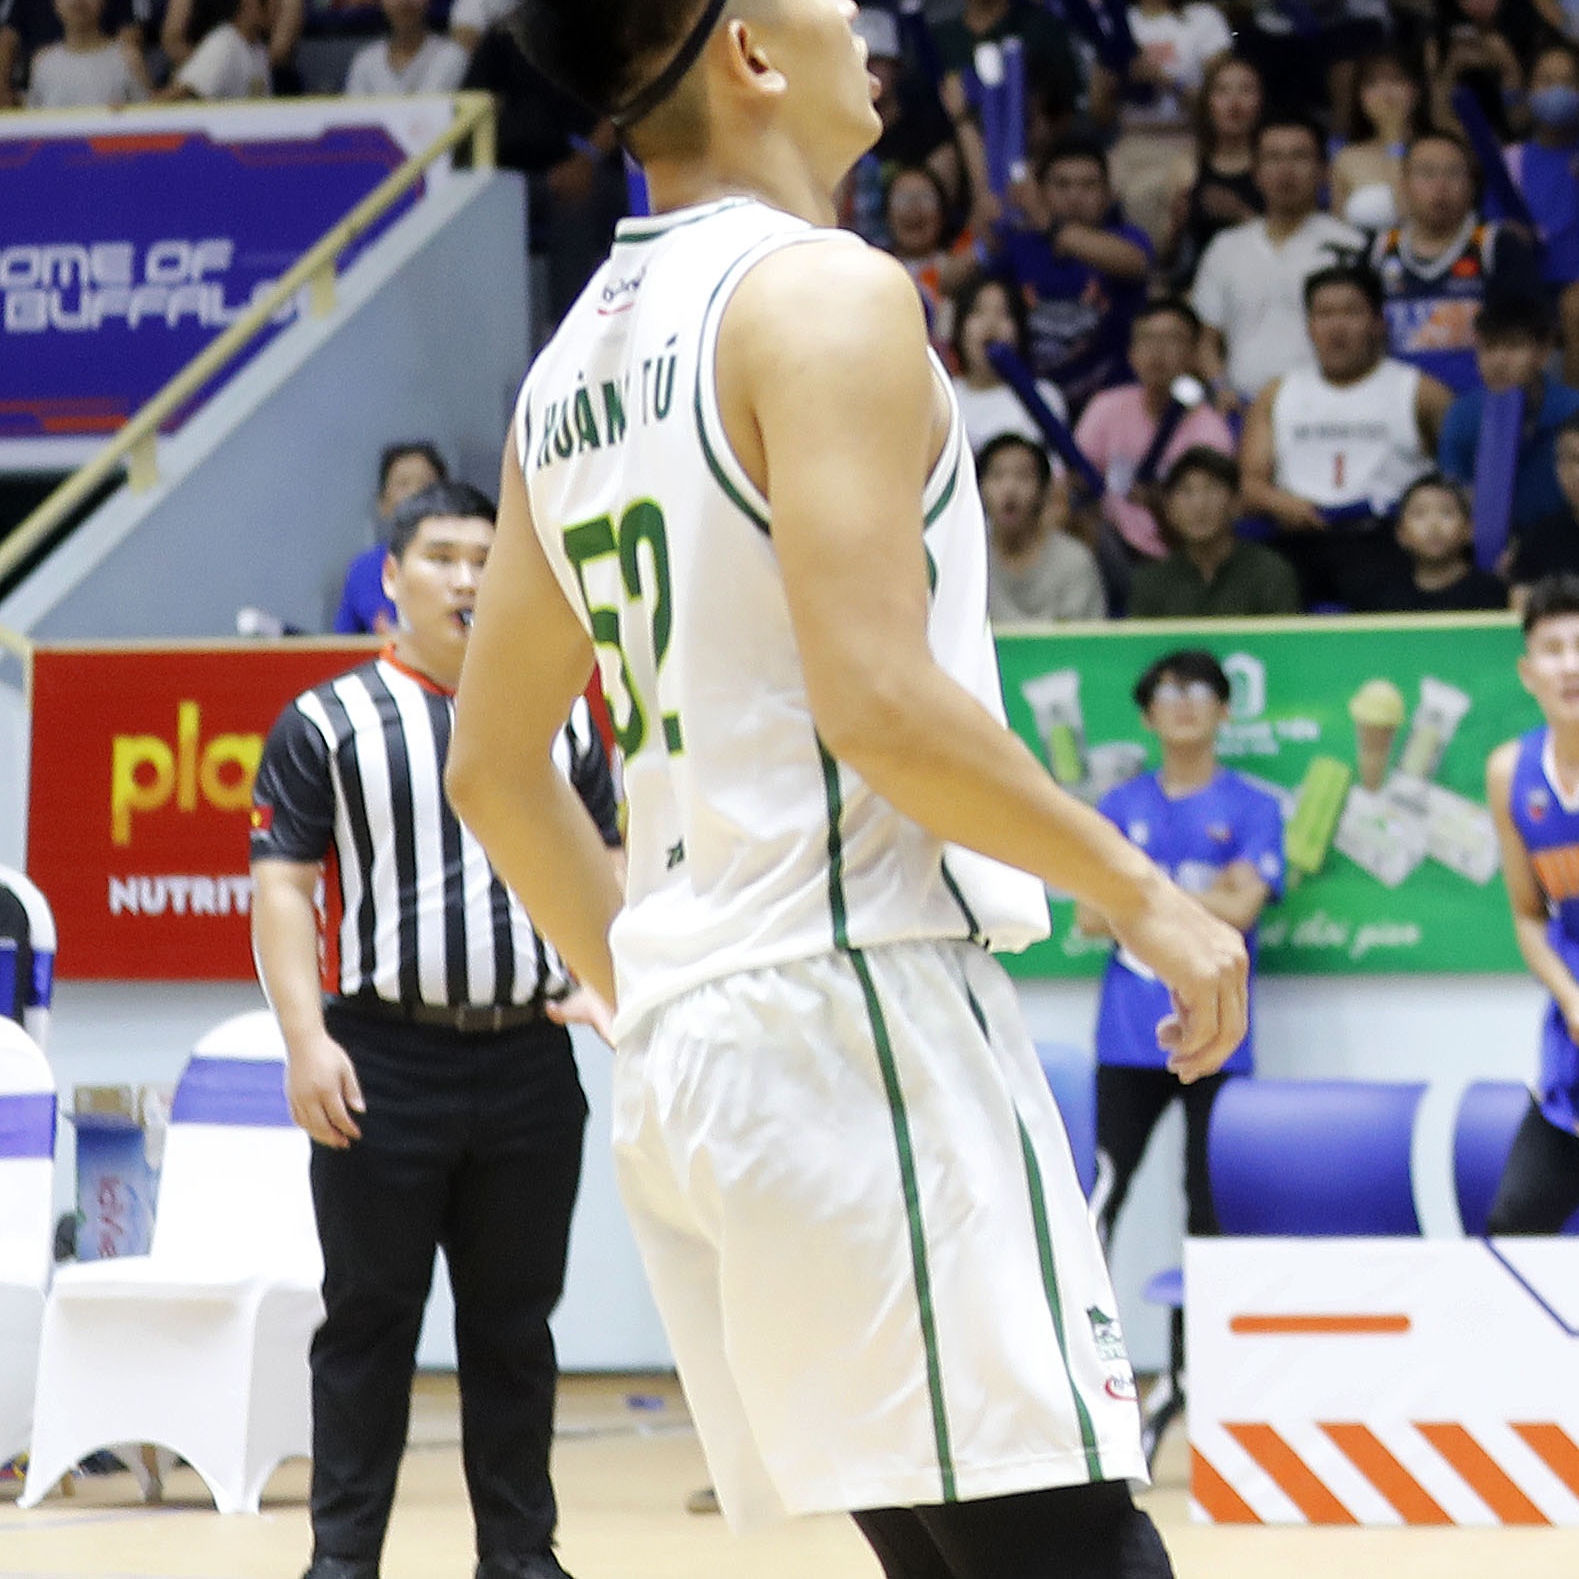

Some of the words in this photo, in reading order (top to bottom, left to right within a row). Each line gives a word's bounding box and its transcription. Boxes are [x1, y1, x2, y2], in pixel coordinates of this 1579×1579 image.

[0, 241, 134, 288] OME
[146, 237, 235, 286] OF
[561, 496, 687, 762] 52
[111, 697, 263, 847] pla
[107, 875, 258, 917] NUTRIT
